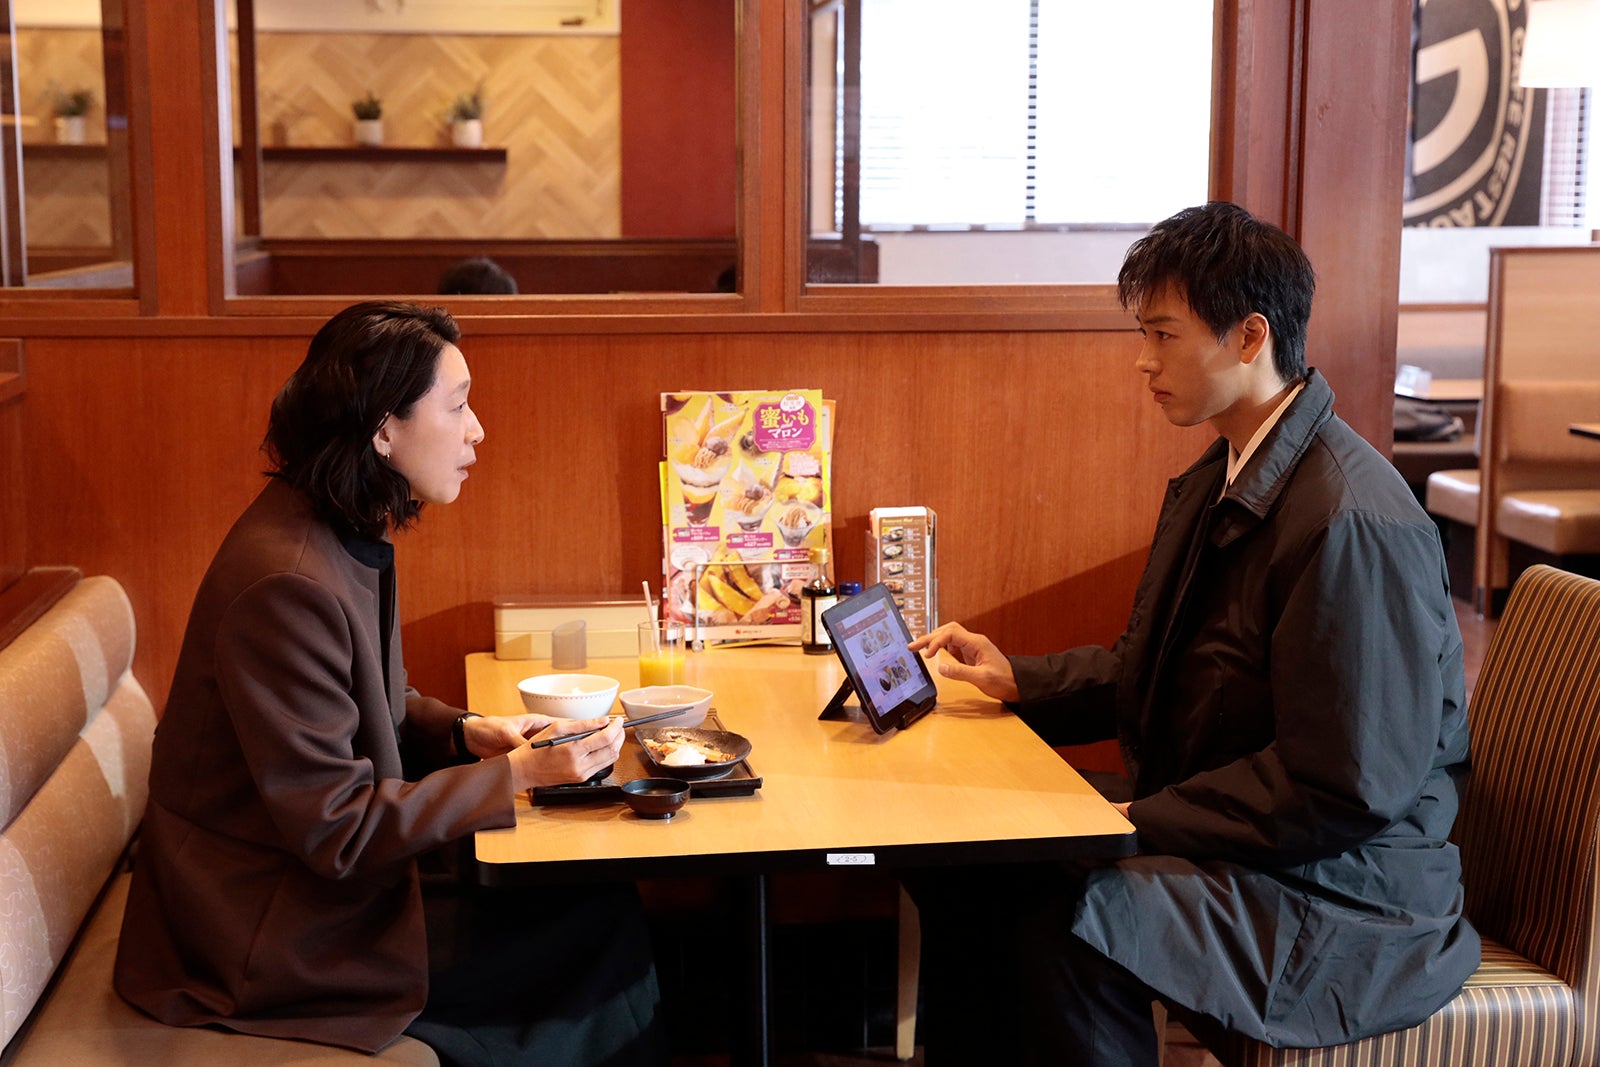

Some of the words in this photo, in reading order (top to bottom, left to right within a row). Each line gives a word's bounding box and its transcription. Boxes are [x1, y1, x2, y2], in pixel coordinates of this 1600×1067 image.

[760, 406, 809, 429] 蜜いも
[768, 427, 803, 439] マロン
